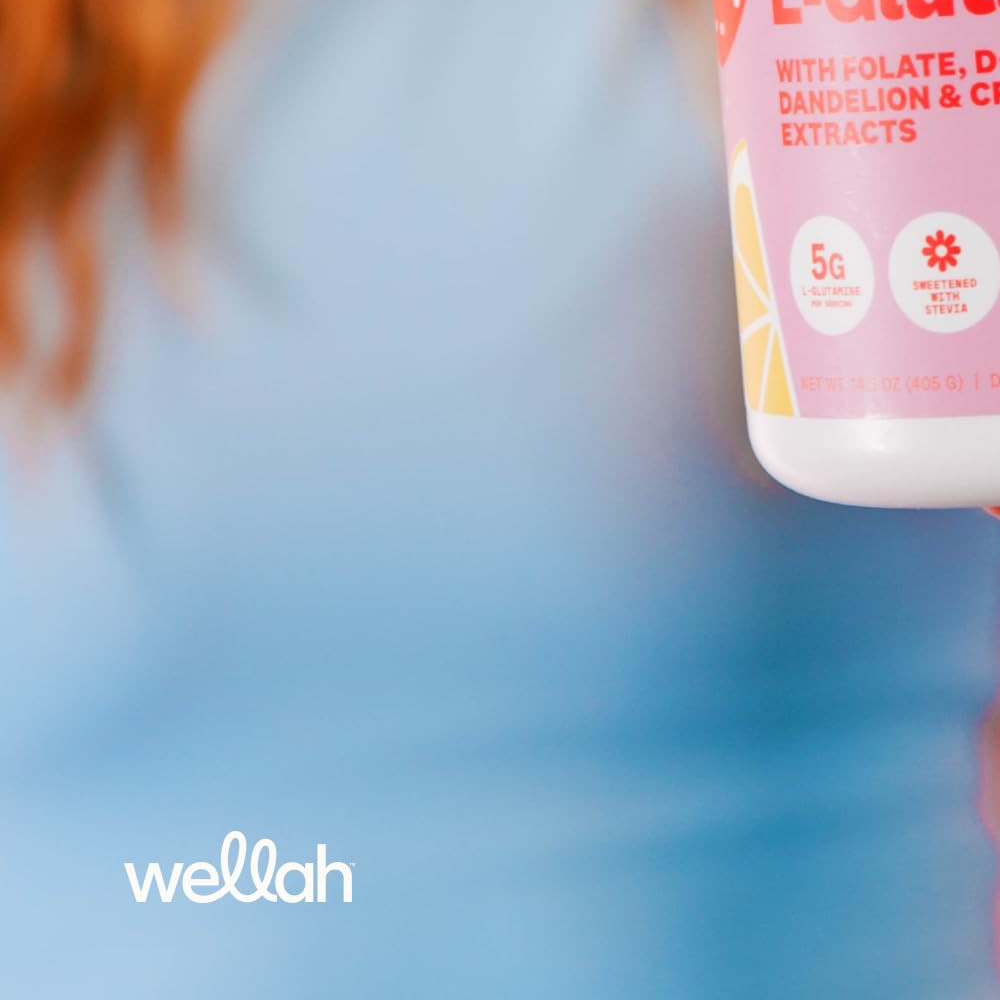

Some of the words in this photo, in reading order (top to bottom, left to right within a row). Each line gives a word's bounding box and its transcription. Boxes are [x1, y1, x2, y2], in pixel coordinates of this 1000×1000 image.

[776, 57, 836, 83] WITH
[843, 52, 968, 82] FOLATE,
[779, 87, 932, 116] DANDELION
[937, 85, 962, 109] &
[781, 118, 918, 147] EXTRACTS
[810, 243, 846, 280] 5G
[912, 278, 978, 290] SWEETENED
[931, 292, 960, 303] WITH
[925, 304, 968, 315] STEVIA
